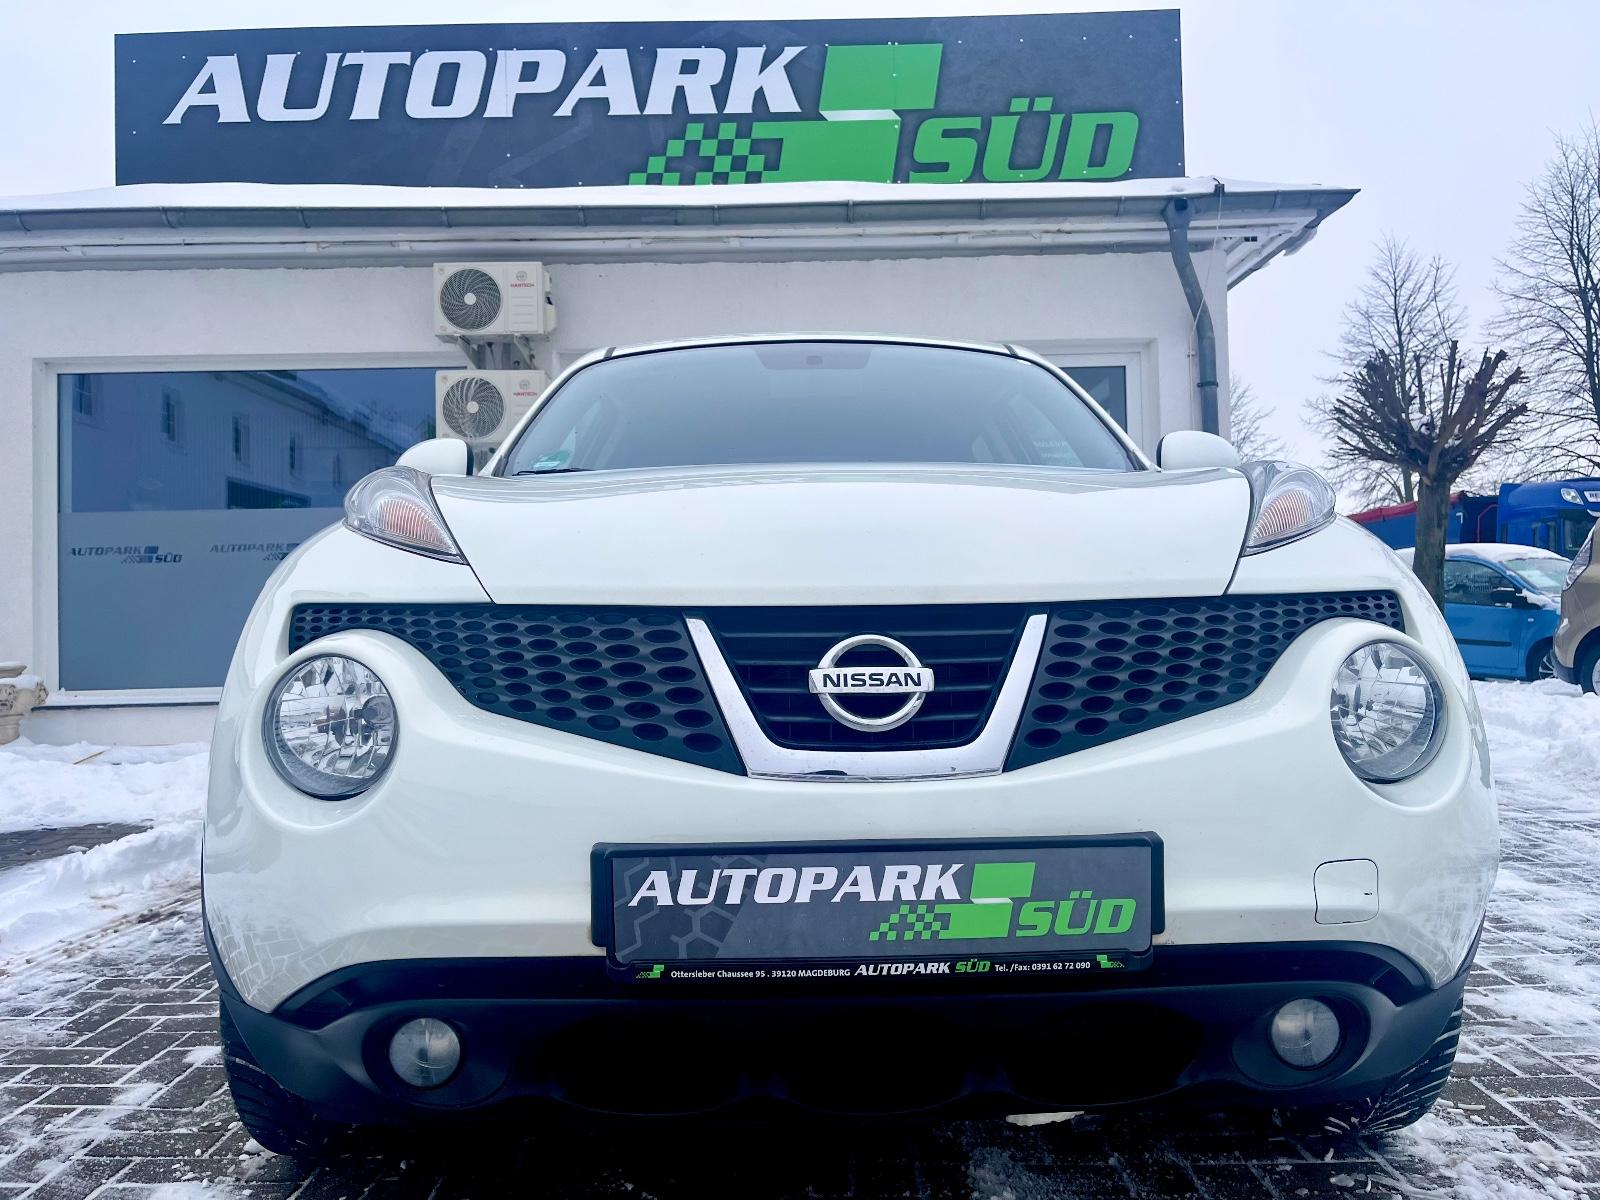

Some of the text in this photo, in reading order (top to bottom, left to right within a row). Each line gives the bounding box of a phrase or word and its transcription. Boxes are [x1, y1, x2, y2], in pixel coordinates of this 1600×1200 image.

[162, 46, 807, 124] AUTOPARK
[909, 97, 1139, 184] SÜD
[70, 546, 141, 557] AUTOPARK
[209, 543, 285, 553] AUTOPARK
[822, 672, 922, 688] NISSAN
[628, 864, 964, 906] AUTOPARK
[1015, 890, 1137, 937] SÜD
[670, 969, 716, 978] Ottersleber
[717, 969, 754, 978] Chaussee
[755, 970, 766, 978] 95
[771, 970, 797, 978] 39120
[798, 968, 851, 977] MAGDEBURG
[854, 962, 950, 976] AUTOPARK
[955, 959, 991, 973] SÜD
[995, 964, 1009, 972] Tel.
[1009, 963, 1030, 973] /Fax:
[1031, 963, 1052, 971] 0391
[1052, 962, 1063, 970] 62
[1064, 962, 1075, 970] 72
[1075, 961, 1091, 969] 090
